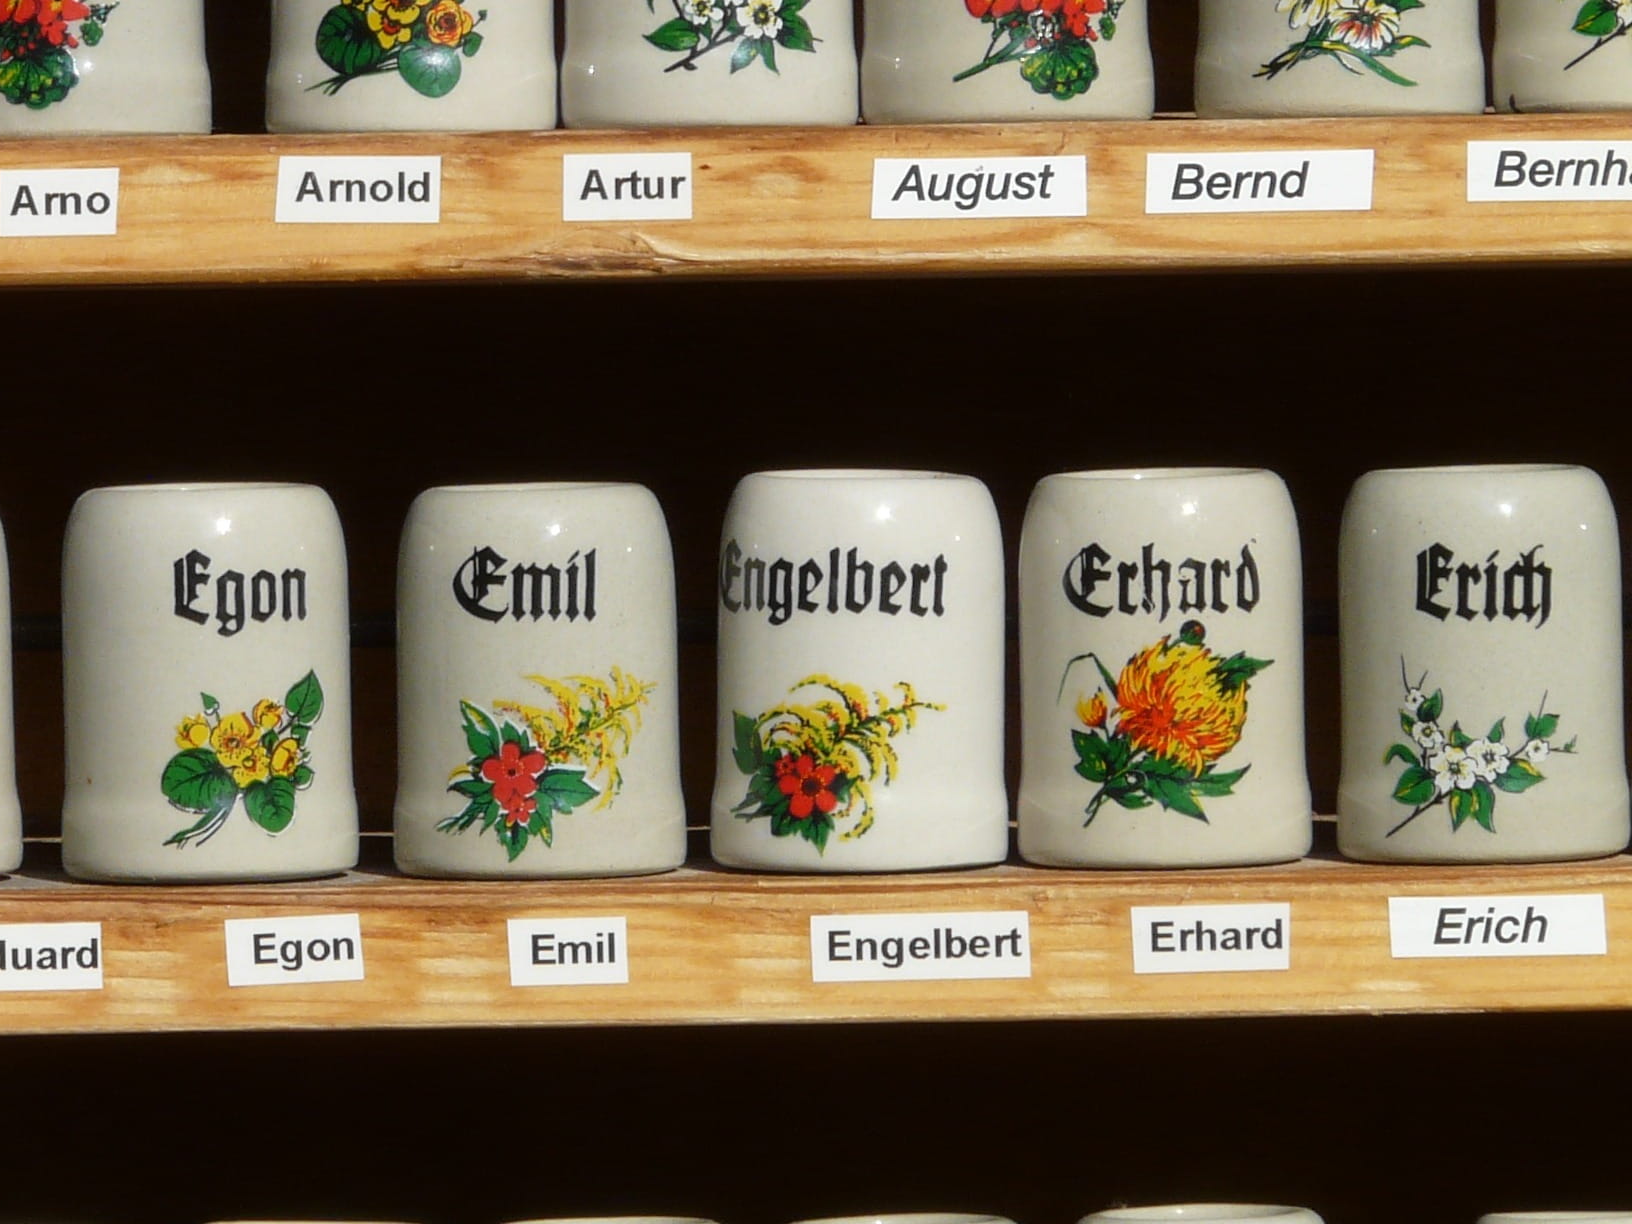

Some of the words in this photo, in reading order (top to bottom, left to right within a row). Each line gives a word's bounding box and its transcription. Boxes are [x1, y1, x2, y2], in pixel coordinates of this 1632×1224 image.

[296, 172, 430, 202] Arnold
[581, 170, 686, 200] Artur
[892, 165, 1054, 210] August
[1172, 161, 1309, 200] Bernd
[1495, 150, 1632, 187] Bernh
[11, 185, 110, 216] Arno
[174, 550, 306, 637] Egon
[452, 546, 595, 623] Emil
[724, 537, 947, 626] Engelbert
[1062, 543, 1259, 621] Erhard
[1416, 543, 1551, 628] Erich
[1151, 919, 1282, 952] Erhard
[1434, 907, 1547, 944] Erich
[253, 933, 354, 971] Egon
[532, 933, 615, 964] Emil
[829, 928, 1021, 968] Engelbert
